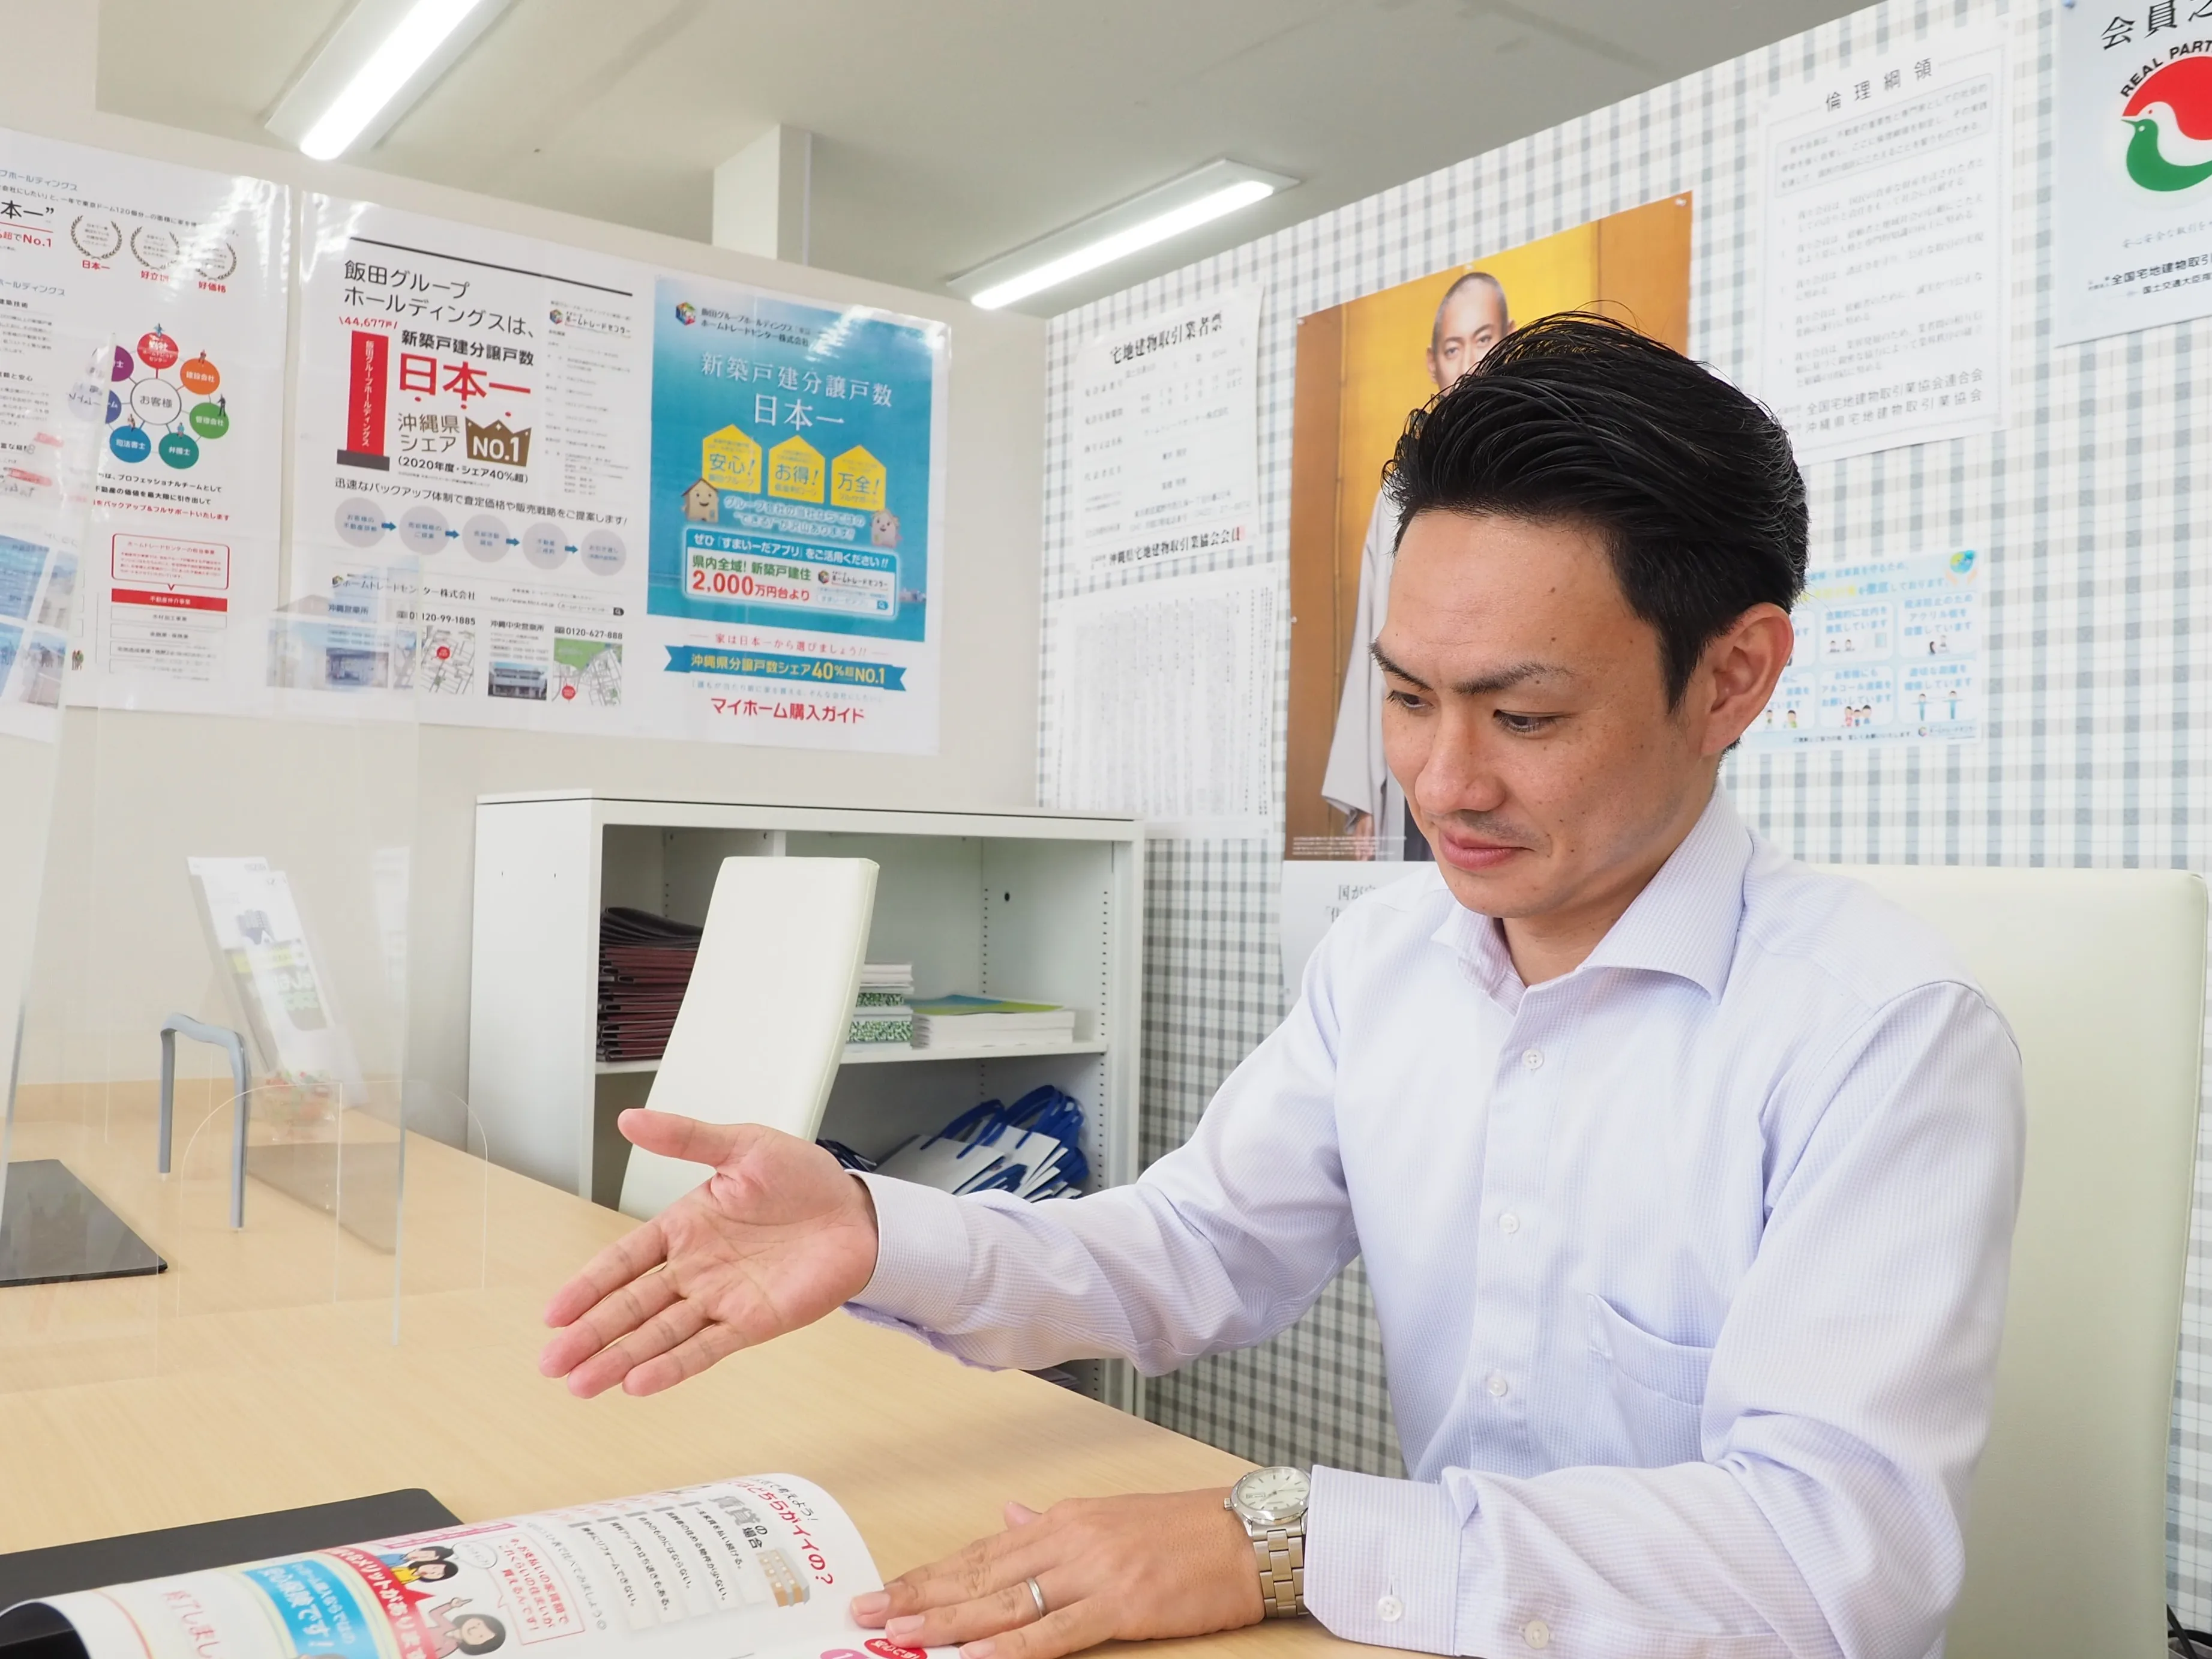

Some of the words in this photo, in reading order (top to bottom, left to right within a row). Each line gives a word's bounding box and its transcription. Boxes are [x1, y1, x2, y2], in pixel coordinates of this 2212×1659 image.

[1825, 58, 1932, 113] 倫理綱領
[2120, 58, 2163, 97] REAL
[82, 260, 110, 270] 日本一
[344, 259, 470, 299] 飯田グループ
[199, 281, 226, 293] 好価格
[344, 286, 534, 338] ホールディングスは、
[401, 330, 534, 367] 新築戸建分譲戸数
[362, 340, 374, 448] 飯田グループホールディングス
[399, 352, 532, 401] 日本一
[701, 351, 893, 408] 新築戸建分譲戸数
[140, 396, 173, 408] お客様
[754, 393, 845, 431] 日本一
[397, 411, 461, 433] 沖縄県
[400, 434, 456, 454] シェア
[473, 435, 520, 462] NO.1
[566, 627, 624, 640] 0120-627-888
[711, 697, 865, 724] マイホーム購入ガイド
